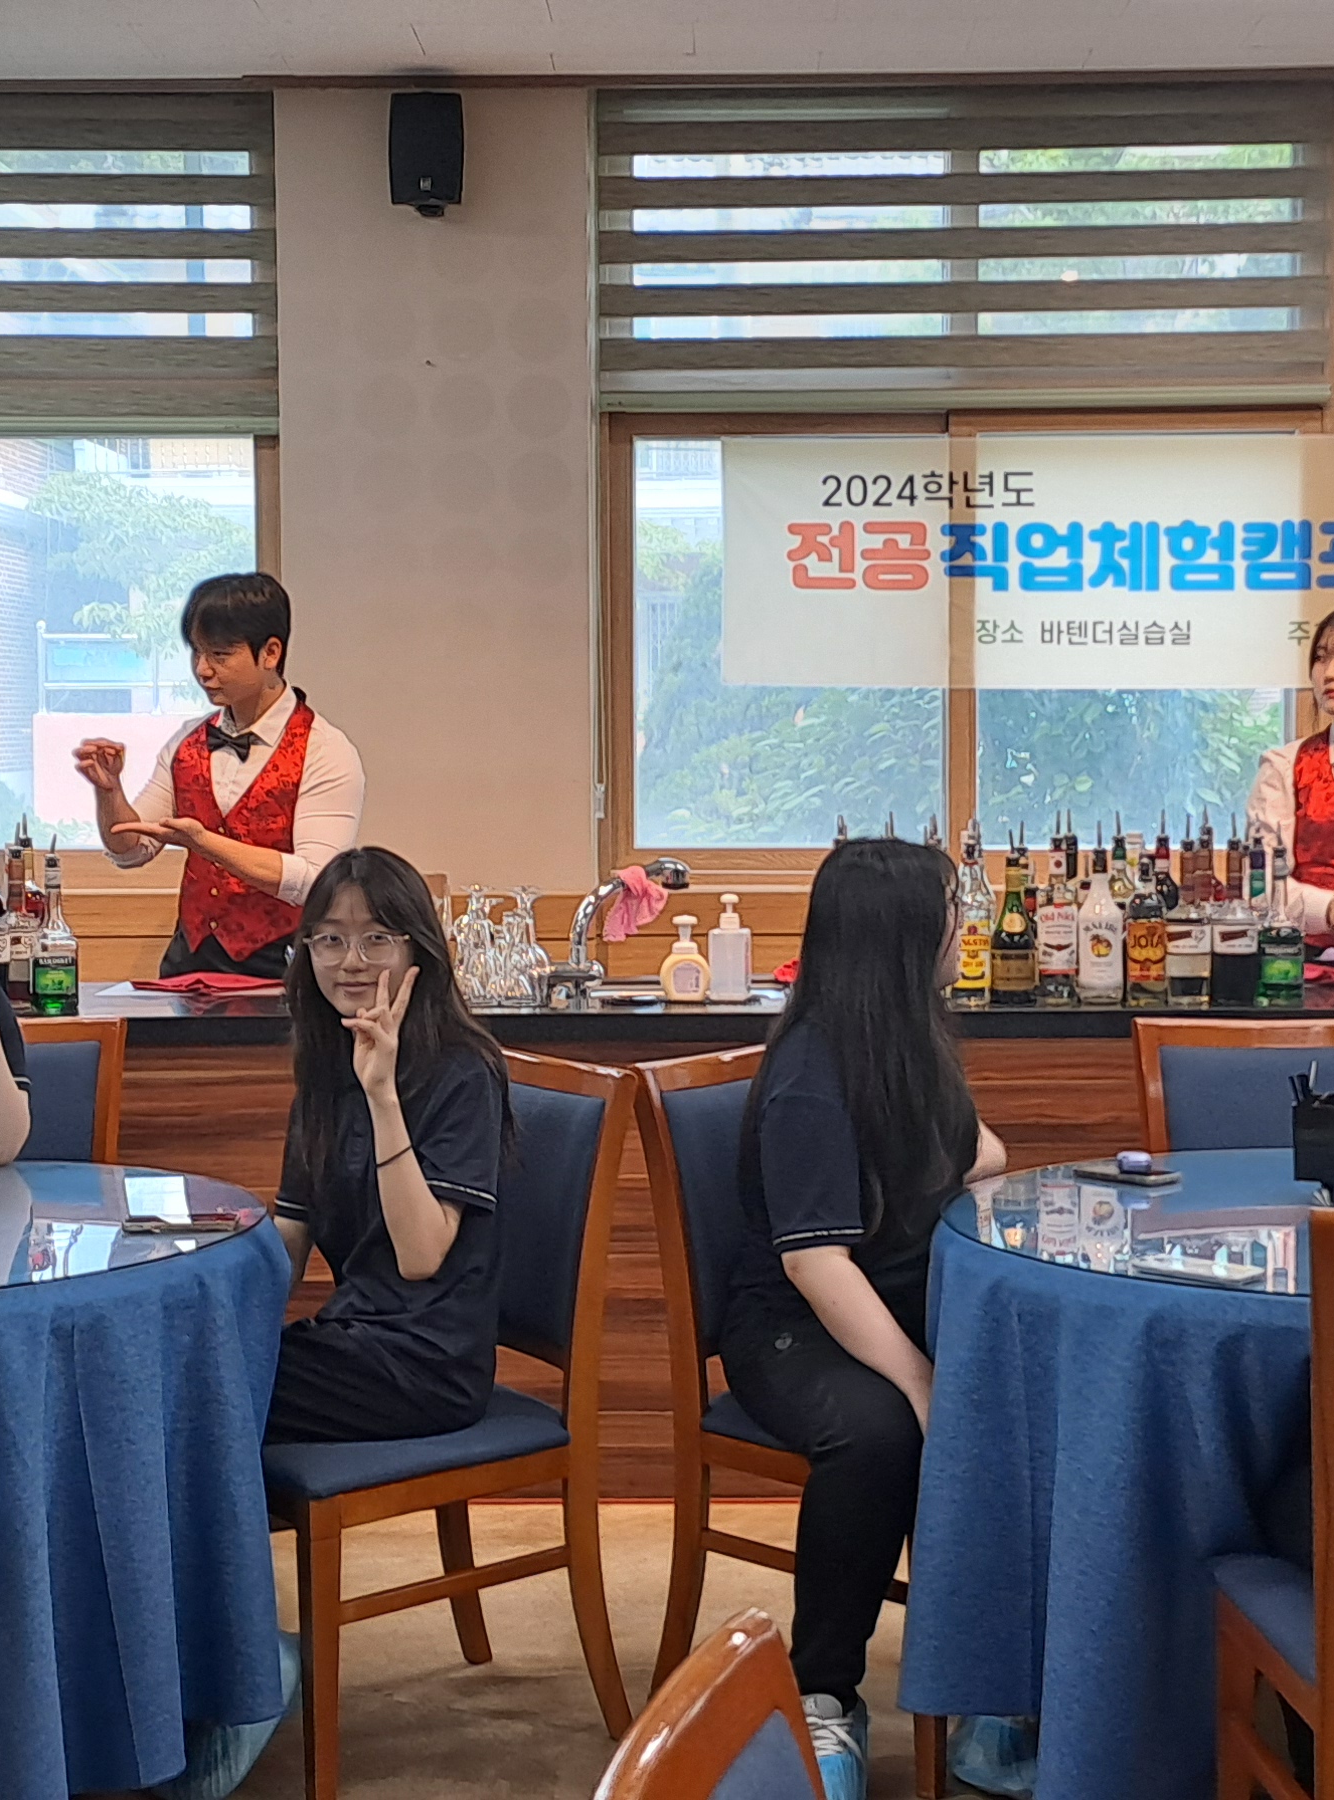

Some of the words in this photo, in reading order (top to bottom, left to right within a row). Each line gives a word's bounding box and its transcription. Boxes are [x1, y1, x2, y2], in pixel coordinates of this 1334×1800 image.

[821, 470, 1035, 508] 2024학년도
[975, 618, 1024, 645] 장소
[1040, 618, 1192, 646] 바텐더실습실
